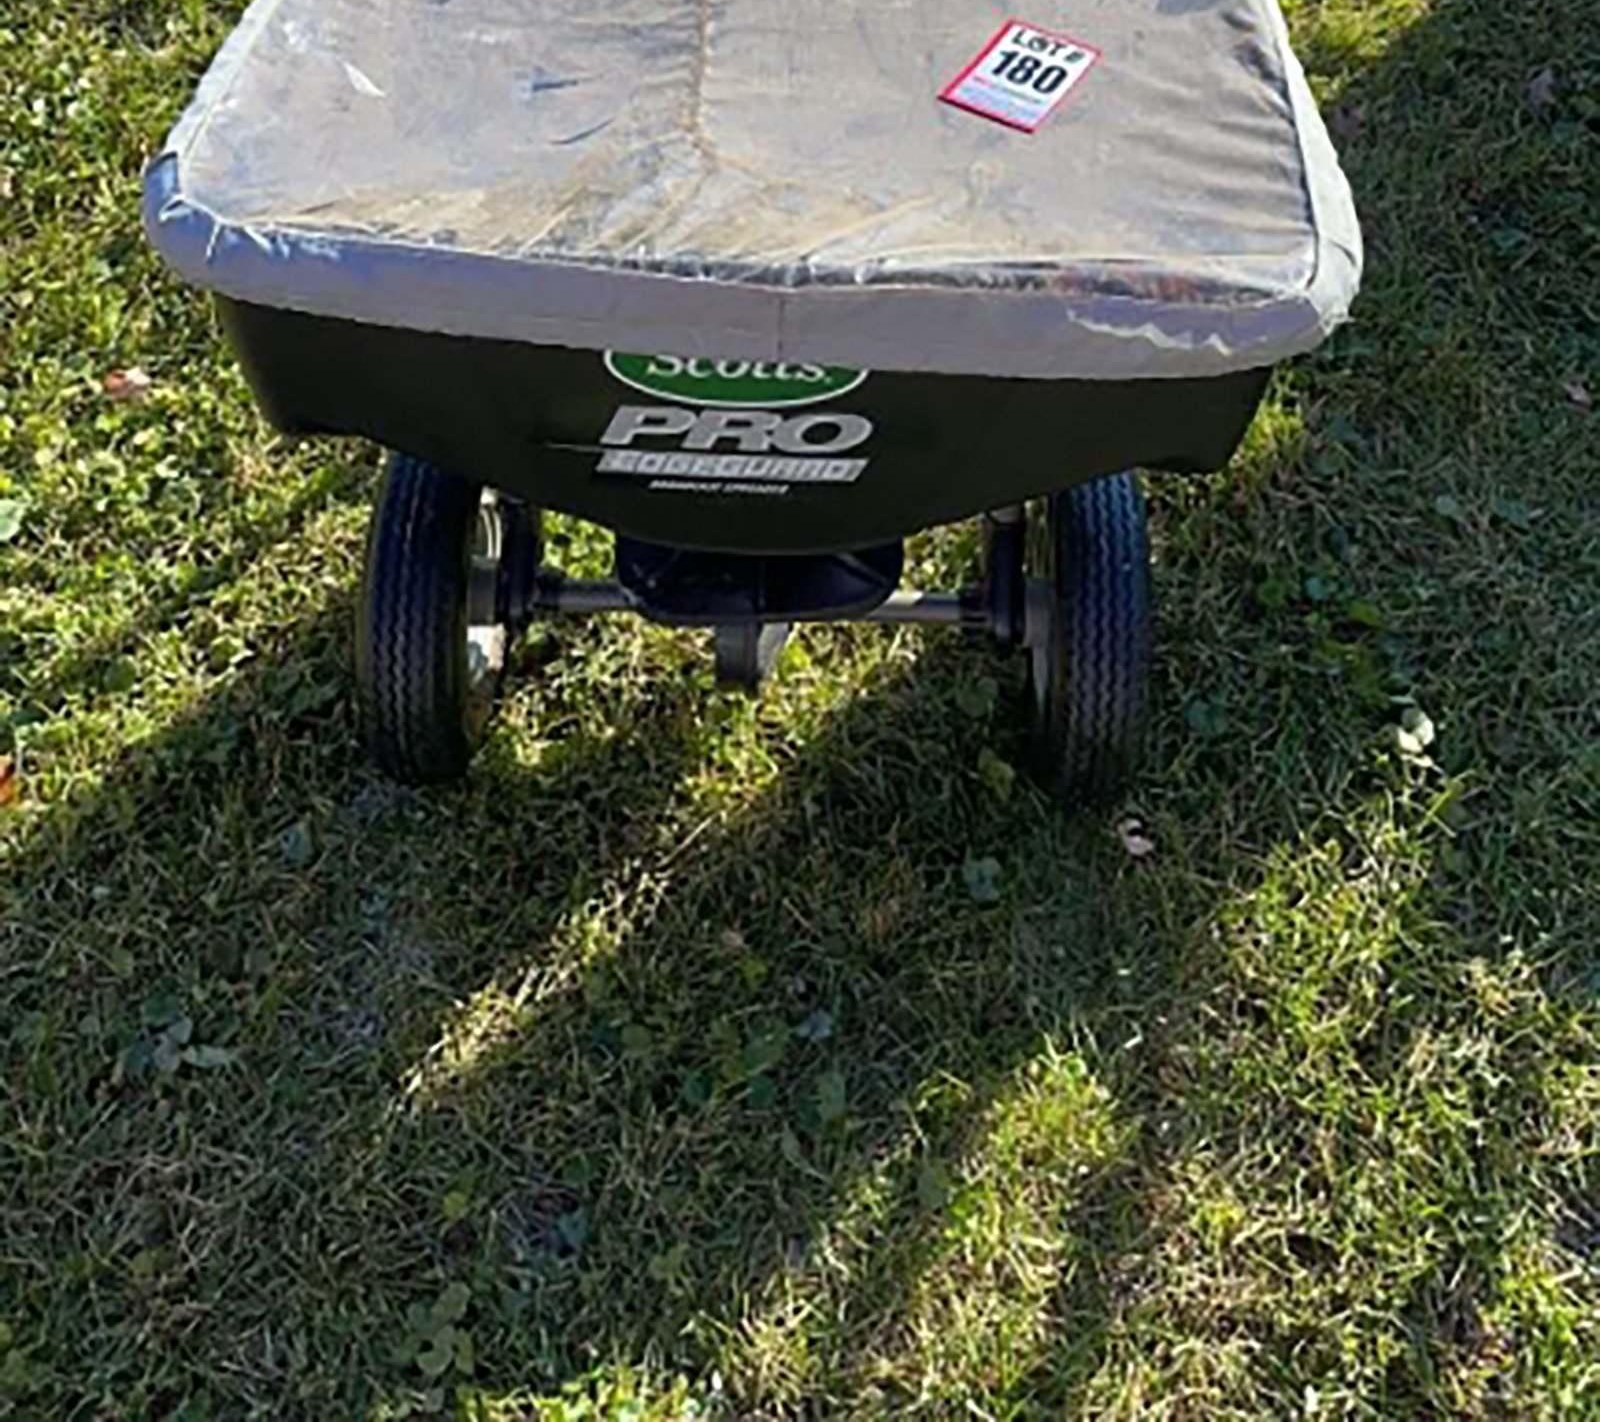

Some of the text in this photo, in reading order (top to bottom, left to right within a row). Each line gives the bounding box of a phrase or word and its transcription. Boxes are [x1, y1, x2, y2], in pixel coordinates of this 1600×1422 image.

[1011, 29, 1067, 56] LOT
[991, 49, 1068, 95] 180
[600, 405, 873, 454] PRO
